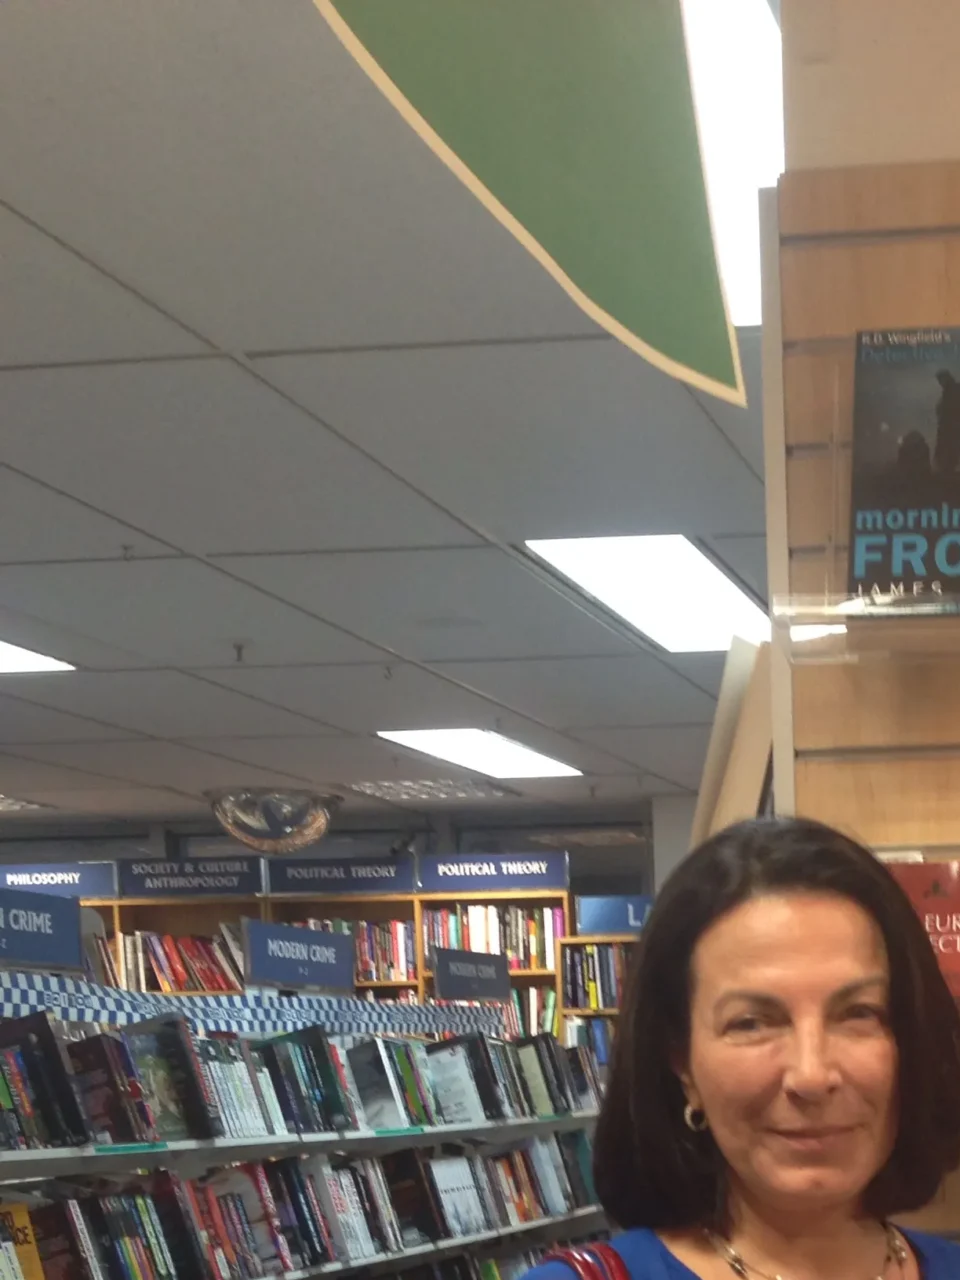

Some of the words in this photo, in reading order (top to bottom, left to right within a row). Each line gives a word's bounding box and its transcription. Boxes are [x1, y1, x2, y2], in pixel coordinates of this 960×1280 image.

[131, 861, 180, 875] SOCIETY
[184, 862, 195, 874] &
[198, 860, 249, 874] CULTURE
[286, 865, 346, 879] POLITICAL
[350, 864, 397, 878] THEORY
[437, 861, 497, 877] POLITICAL
[501, 860, 549, 875] THEORY
[6, 872, 81, 886] PHILOSOPHY
[144, 874, 240, 889] ANTHROPOLOGY
[9, 908, 53, 934] CRIME
[267, 937, 308, 962] MODERN
[309, 943, 337, 965] CRIME
